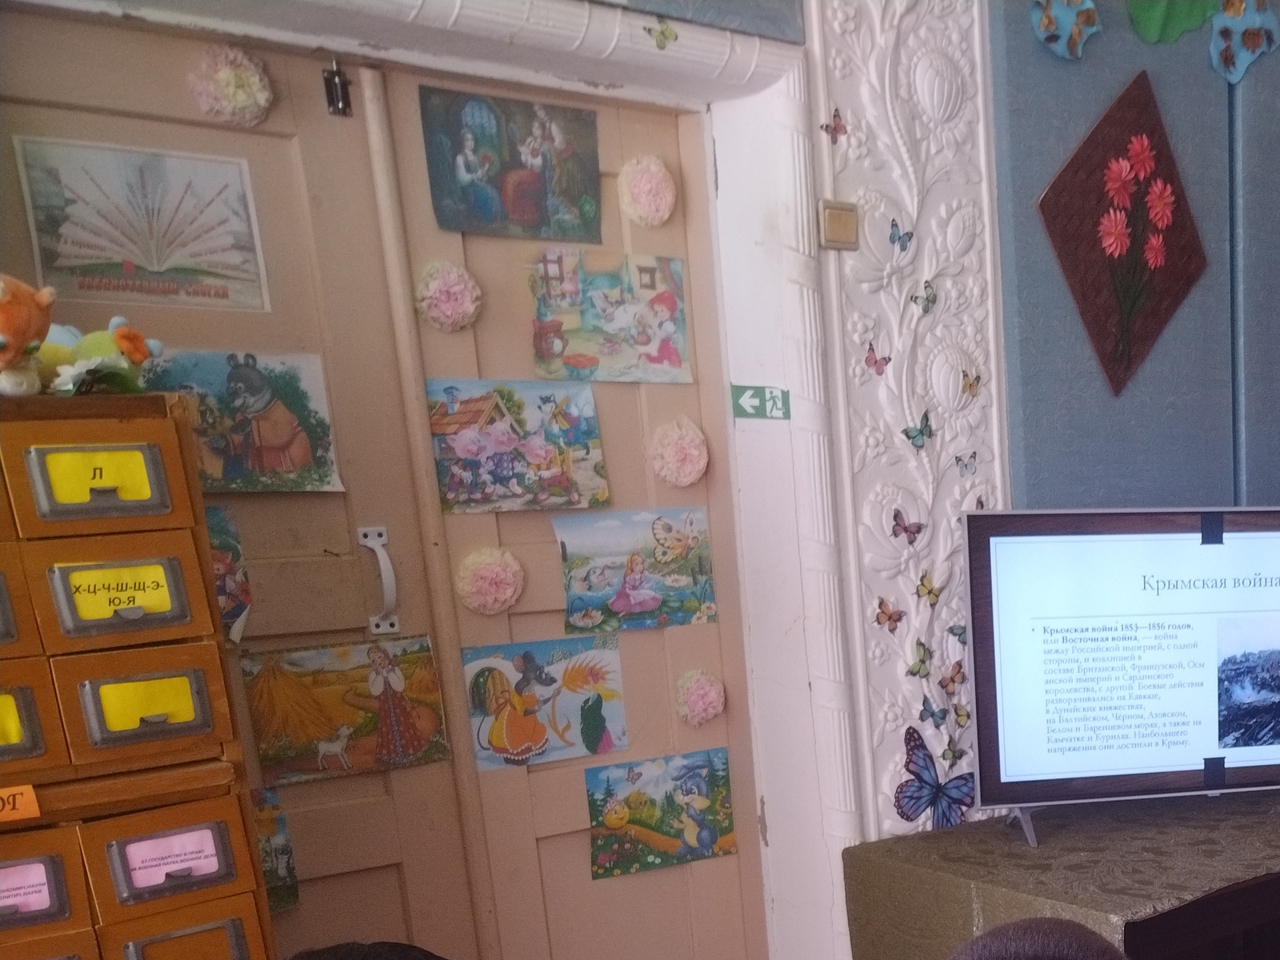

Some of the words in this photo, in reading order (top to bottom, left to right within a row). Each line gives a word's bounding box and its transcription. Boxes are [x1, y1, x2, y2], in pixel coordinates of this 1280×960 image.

[91, 467, 103, 481] Л
[72, 581, 165, 596] Х-Ц-Ч-Ш-Щ-Э-
[1141, 574, 1227, 597] Крымская
[108, 596, 136, 607] Ю-Я
[1043, 626, 1089, 637] Крымская
[1062, 636, 1109, 644] Восточная
[1154, 632, 1178, 641] война
[1043, 647, 1069, 656] между
[1072, 643, 1120, 655] Российской
[1173, 642, 1198, 650] одной
[1044, 668, 1074, 676] составе
[1122, 672, 1174, 684] Сардинского
[1138, 682, 1166, 691] Боевые
[1168, 680, 1204, 690] действия
[1052, 704, 1096, 716] Дунайских
[1046, 726, 1073, 734] Белом
[1083, 723, 1132, 734] Баренцевом
[1047, 735, 1085, 744] Камчатке
[1047, 744, 1097, 756] напряжения
[1116, 741, 1153, 750] достигли
